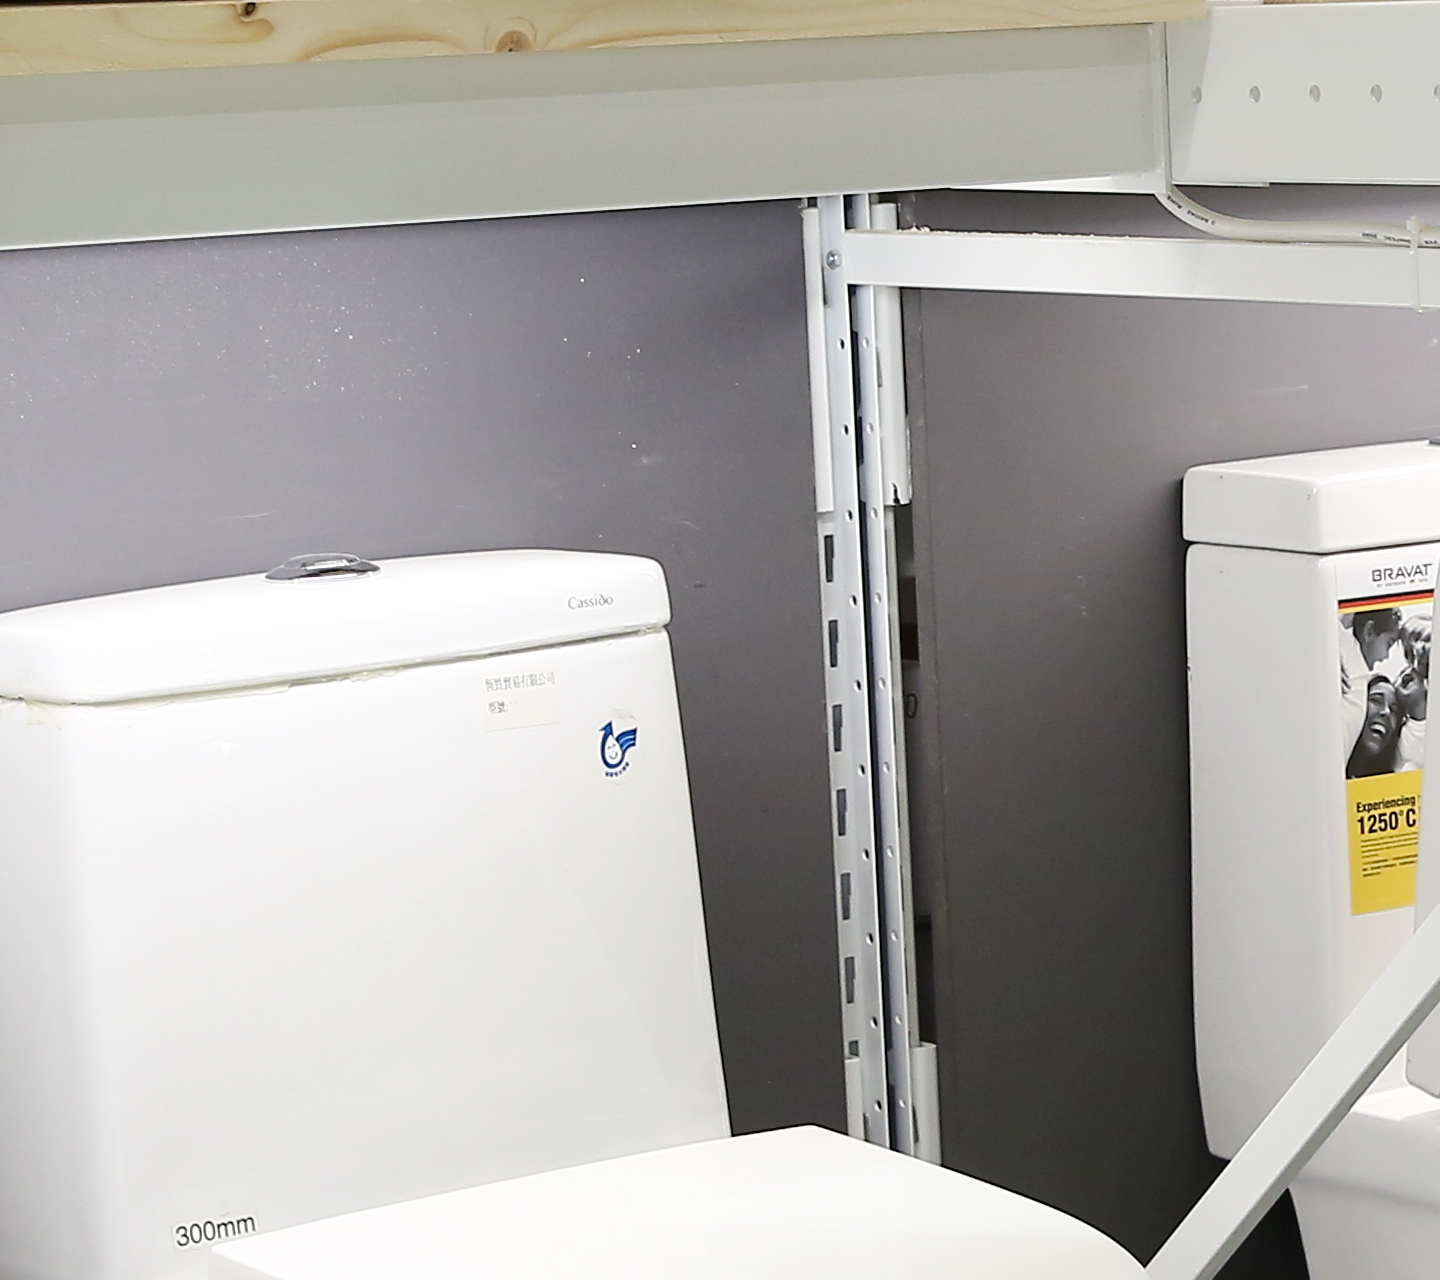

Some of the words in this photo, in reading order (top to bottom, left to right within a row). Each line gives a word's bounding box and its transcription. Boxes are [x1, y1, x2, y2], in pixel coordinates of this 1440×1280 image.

[1371, 562, 1433, 583] BRAVAT
[567, 593, 615, 610] Cassido
[1356, 794, 1417, 814] Experiencing
[175, 1215, 257, 1247] 300mm
